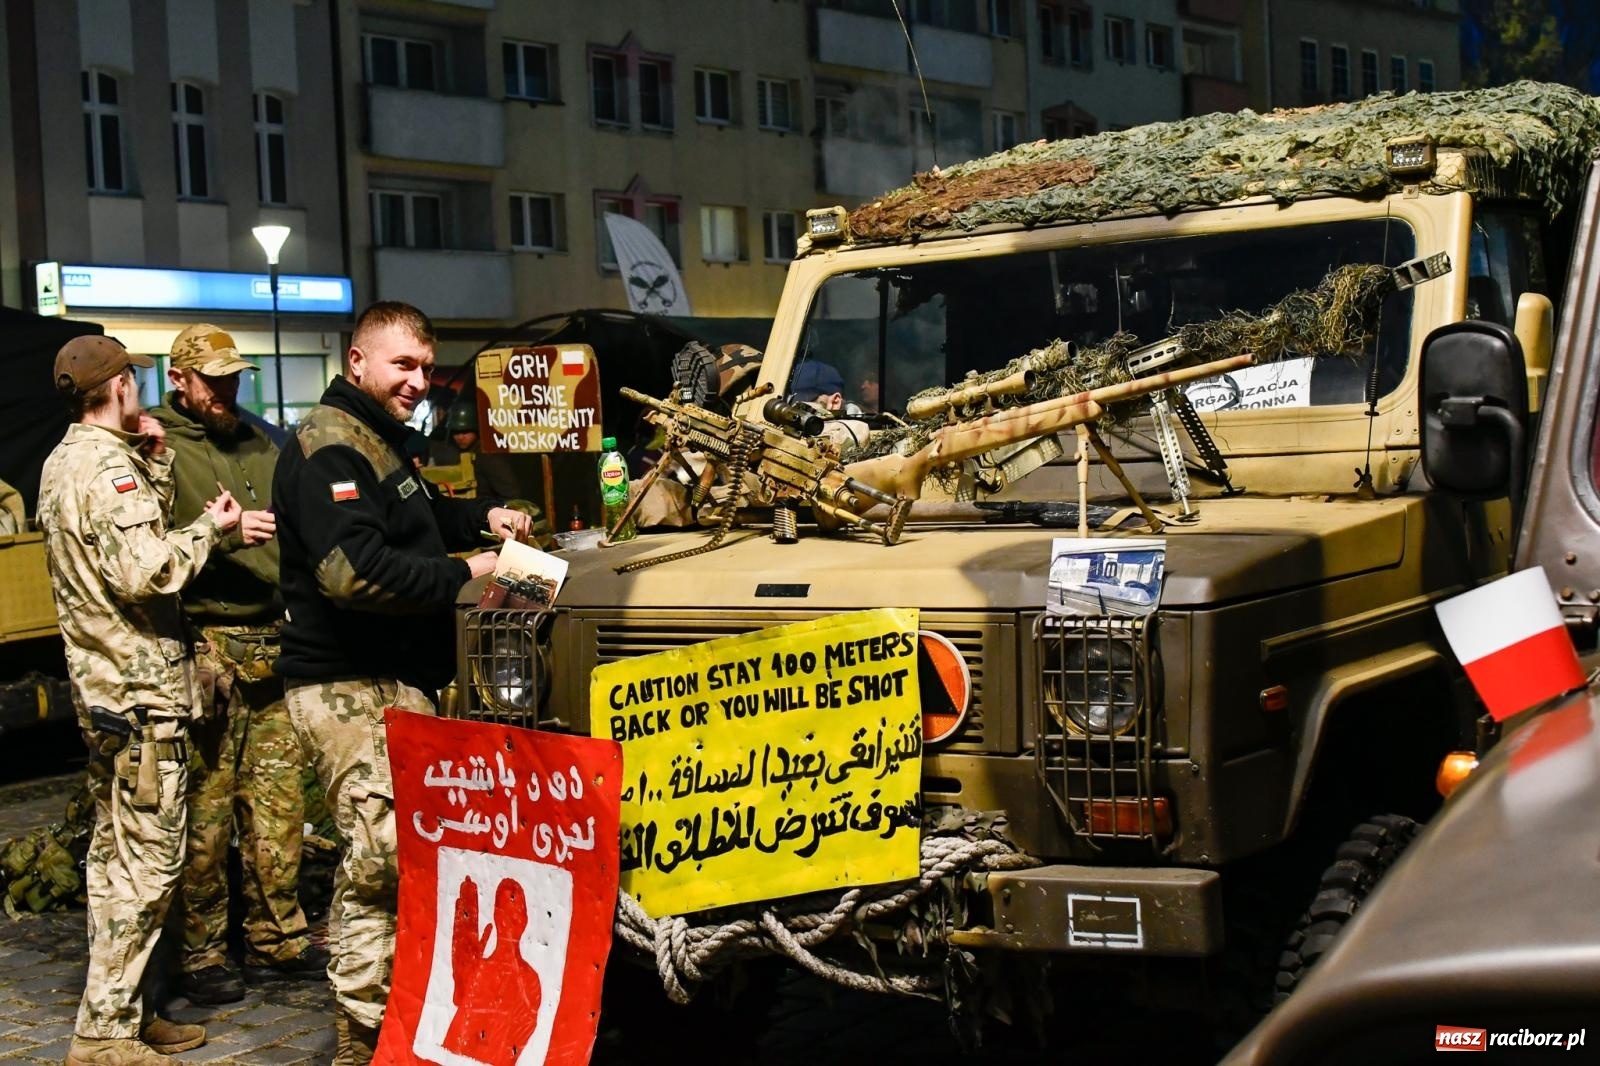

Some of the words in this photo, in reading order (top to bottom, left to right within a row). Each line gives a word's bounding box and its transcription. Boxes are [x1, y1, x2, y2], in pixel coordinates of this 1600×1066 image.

[508, 354, 549, 379] GRH
[498, 384, 567, 407] POLSKIE
[487, 407, 595, 429] KONTYNGENTY
[493, 431, 580, 450] WOJSKOWE
[609, 672, 698, 710] CAUTION
[707, 657, 761, 690] STAY
[771, 652, 816, 678] 100
[825, 631, 915, 670] METERS
[610, 709, 670, 742] BACK
[681, 702, 709, 728] OR
[720, 694, 759, 720] YOU
[763, 686, 809, 713] WILL
[816, 680, 842, 709] BE
[847, 668, 908, 705] SHOT
